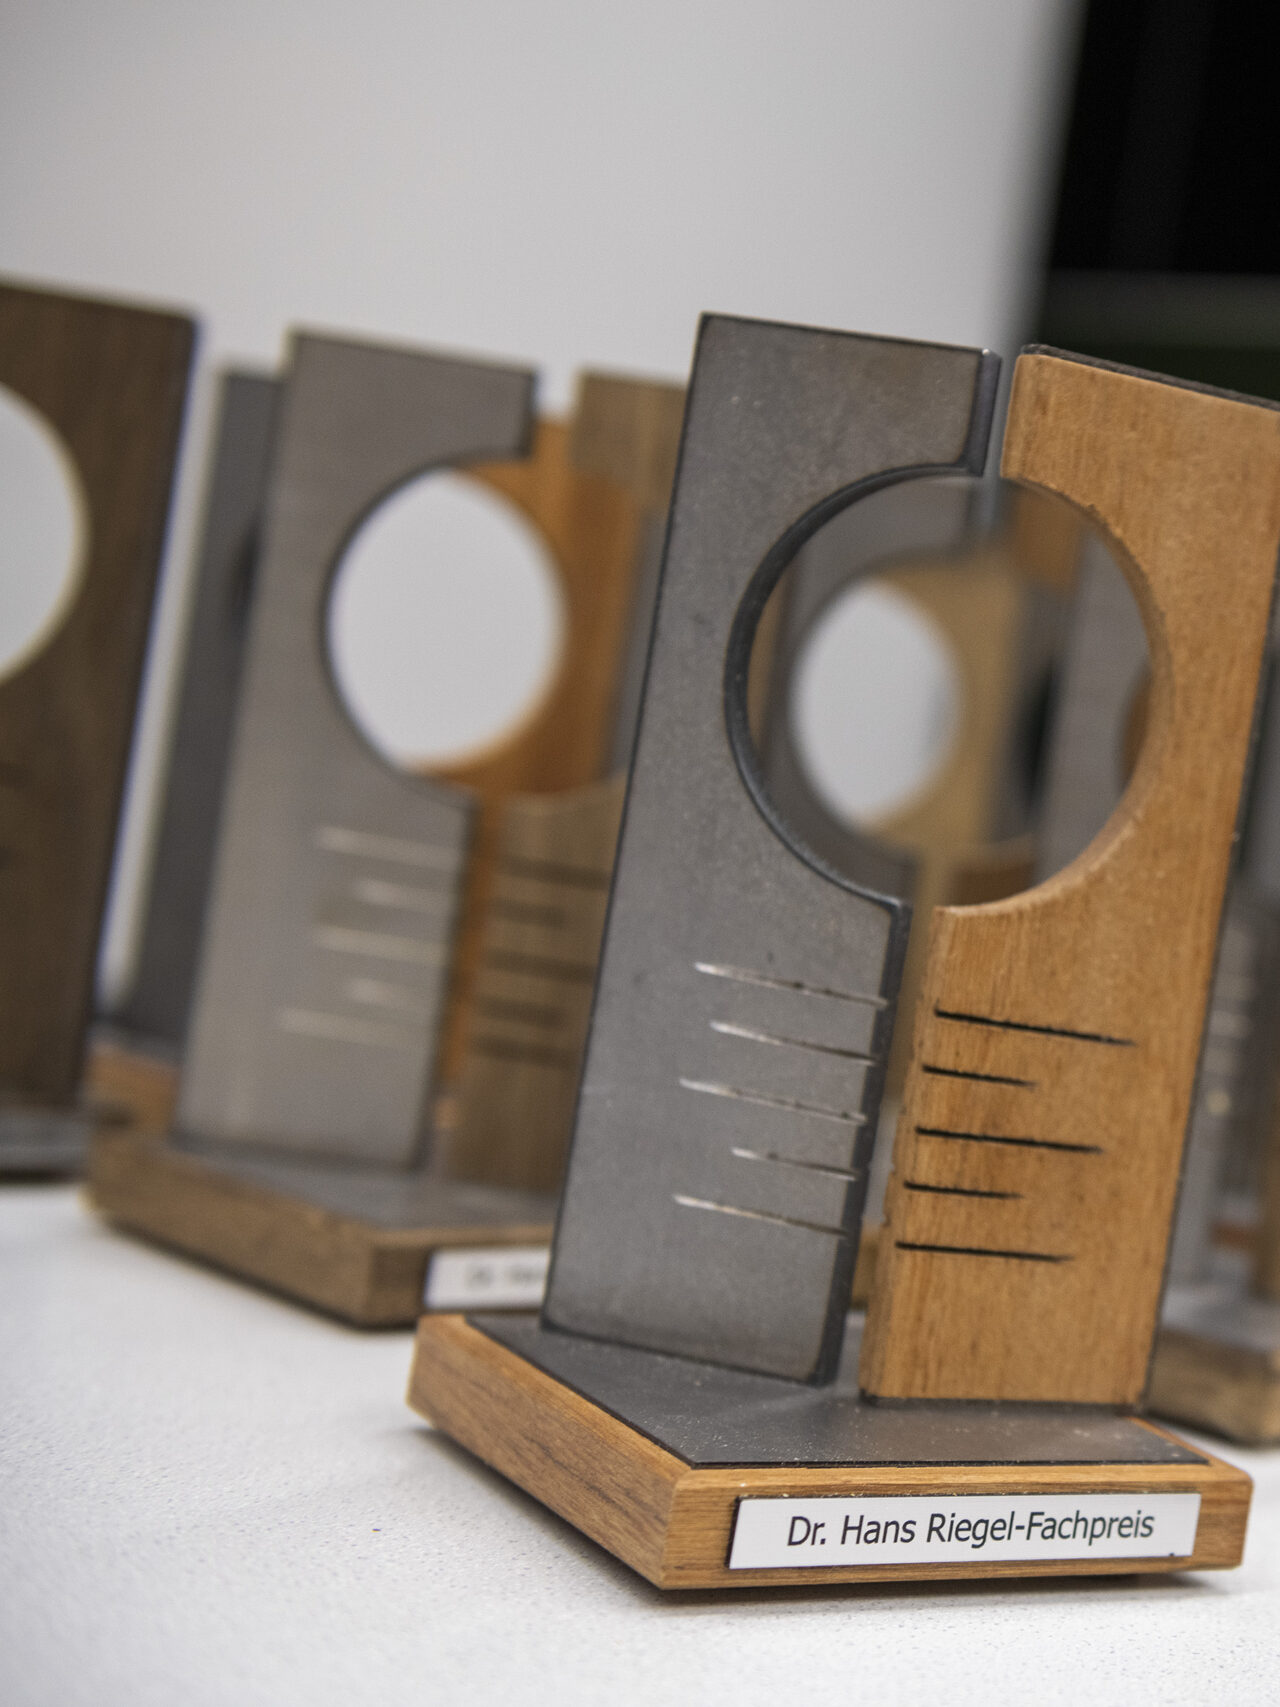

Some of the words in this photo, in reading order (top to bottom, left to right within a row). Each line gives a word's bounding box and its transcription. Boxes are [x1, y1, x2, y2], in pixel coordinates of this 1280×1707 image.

[787, 1516, 826, 1546] Dr.
[840, 1515, 916, 1545] Hans
[926, 1510, 1155, 1548] Riegel-Fachpreis
